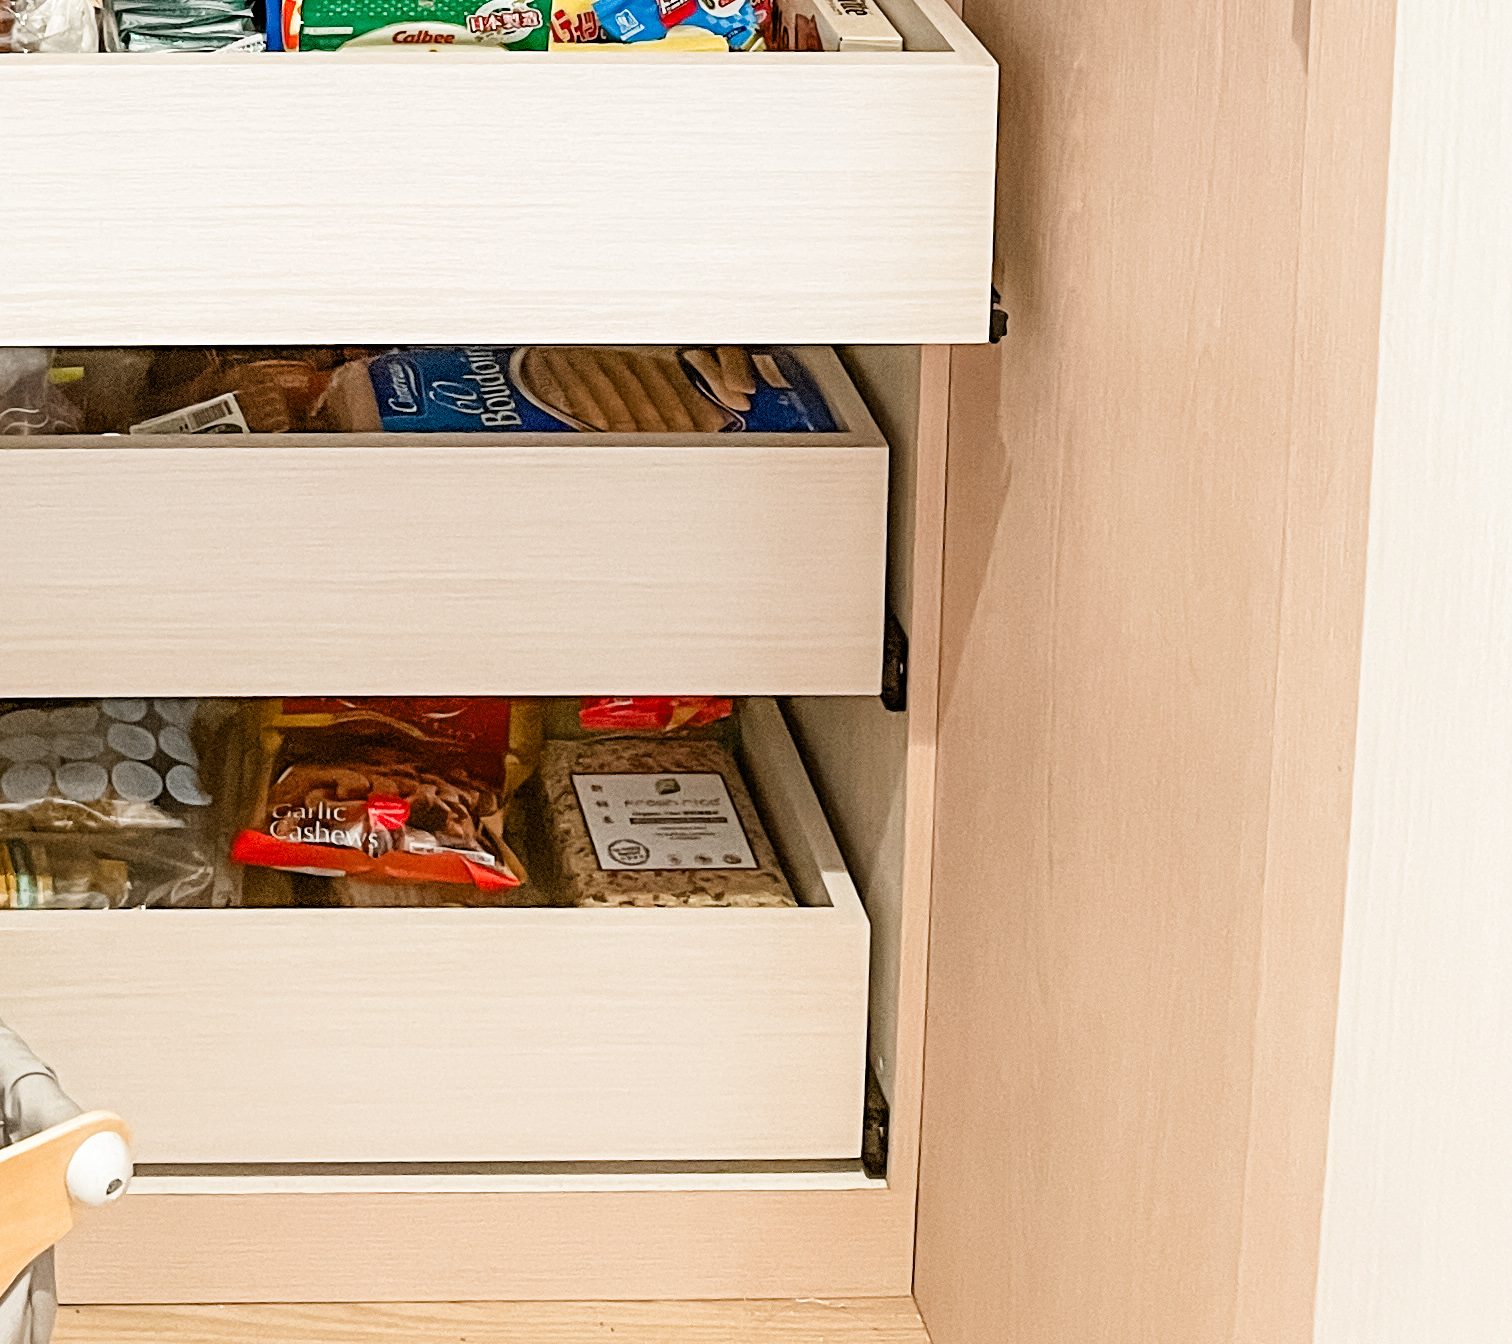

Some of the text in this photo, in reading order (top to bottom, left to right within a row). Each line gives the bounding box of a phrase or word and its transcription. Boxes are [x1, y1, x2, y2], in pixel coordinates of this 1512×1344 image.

[392, 30, 456, 45] Calbee
[272, 801, 348, 822] Garlic
[269, 820, 379, 857] Cashews
